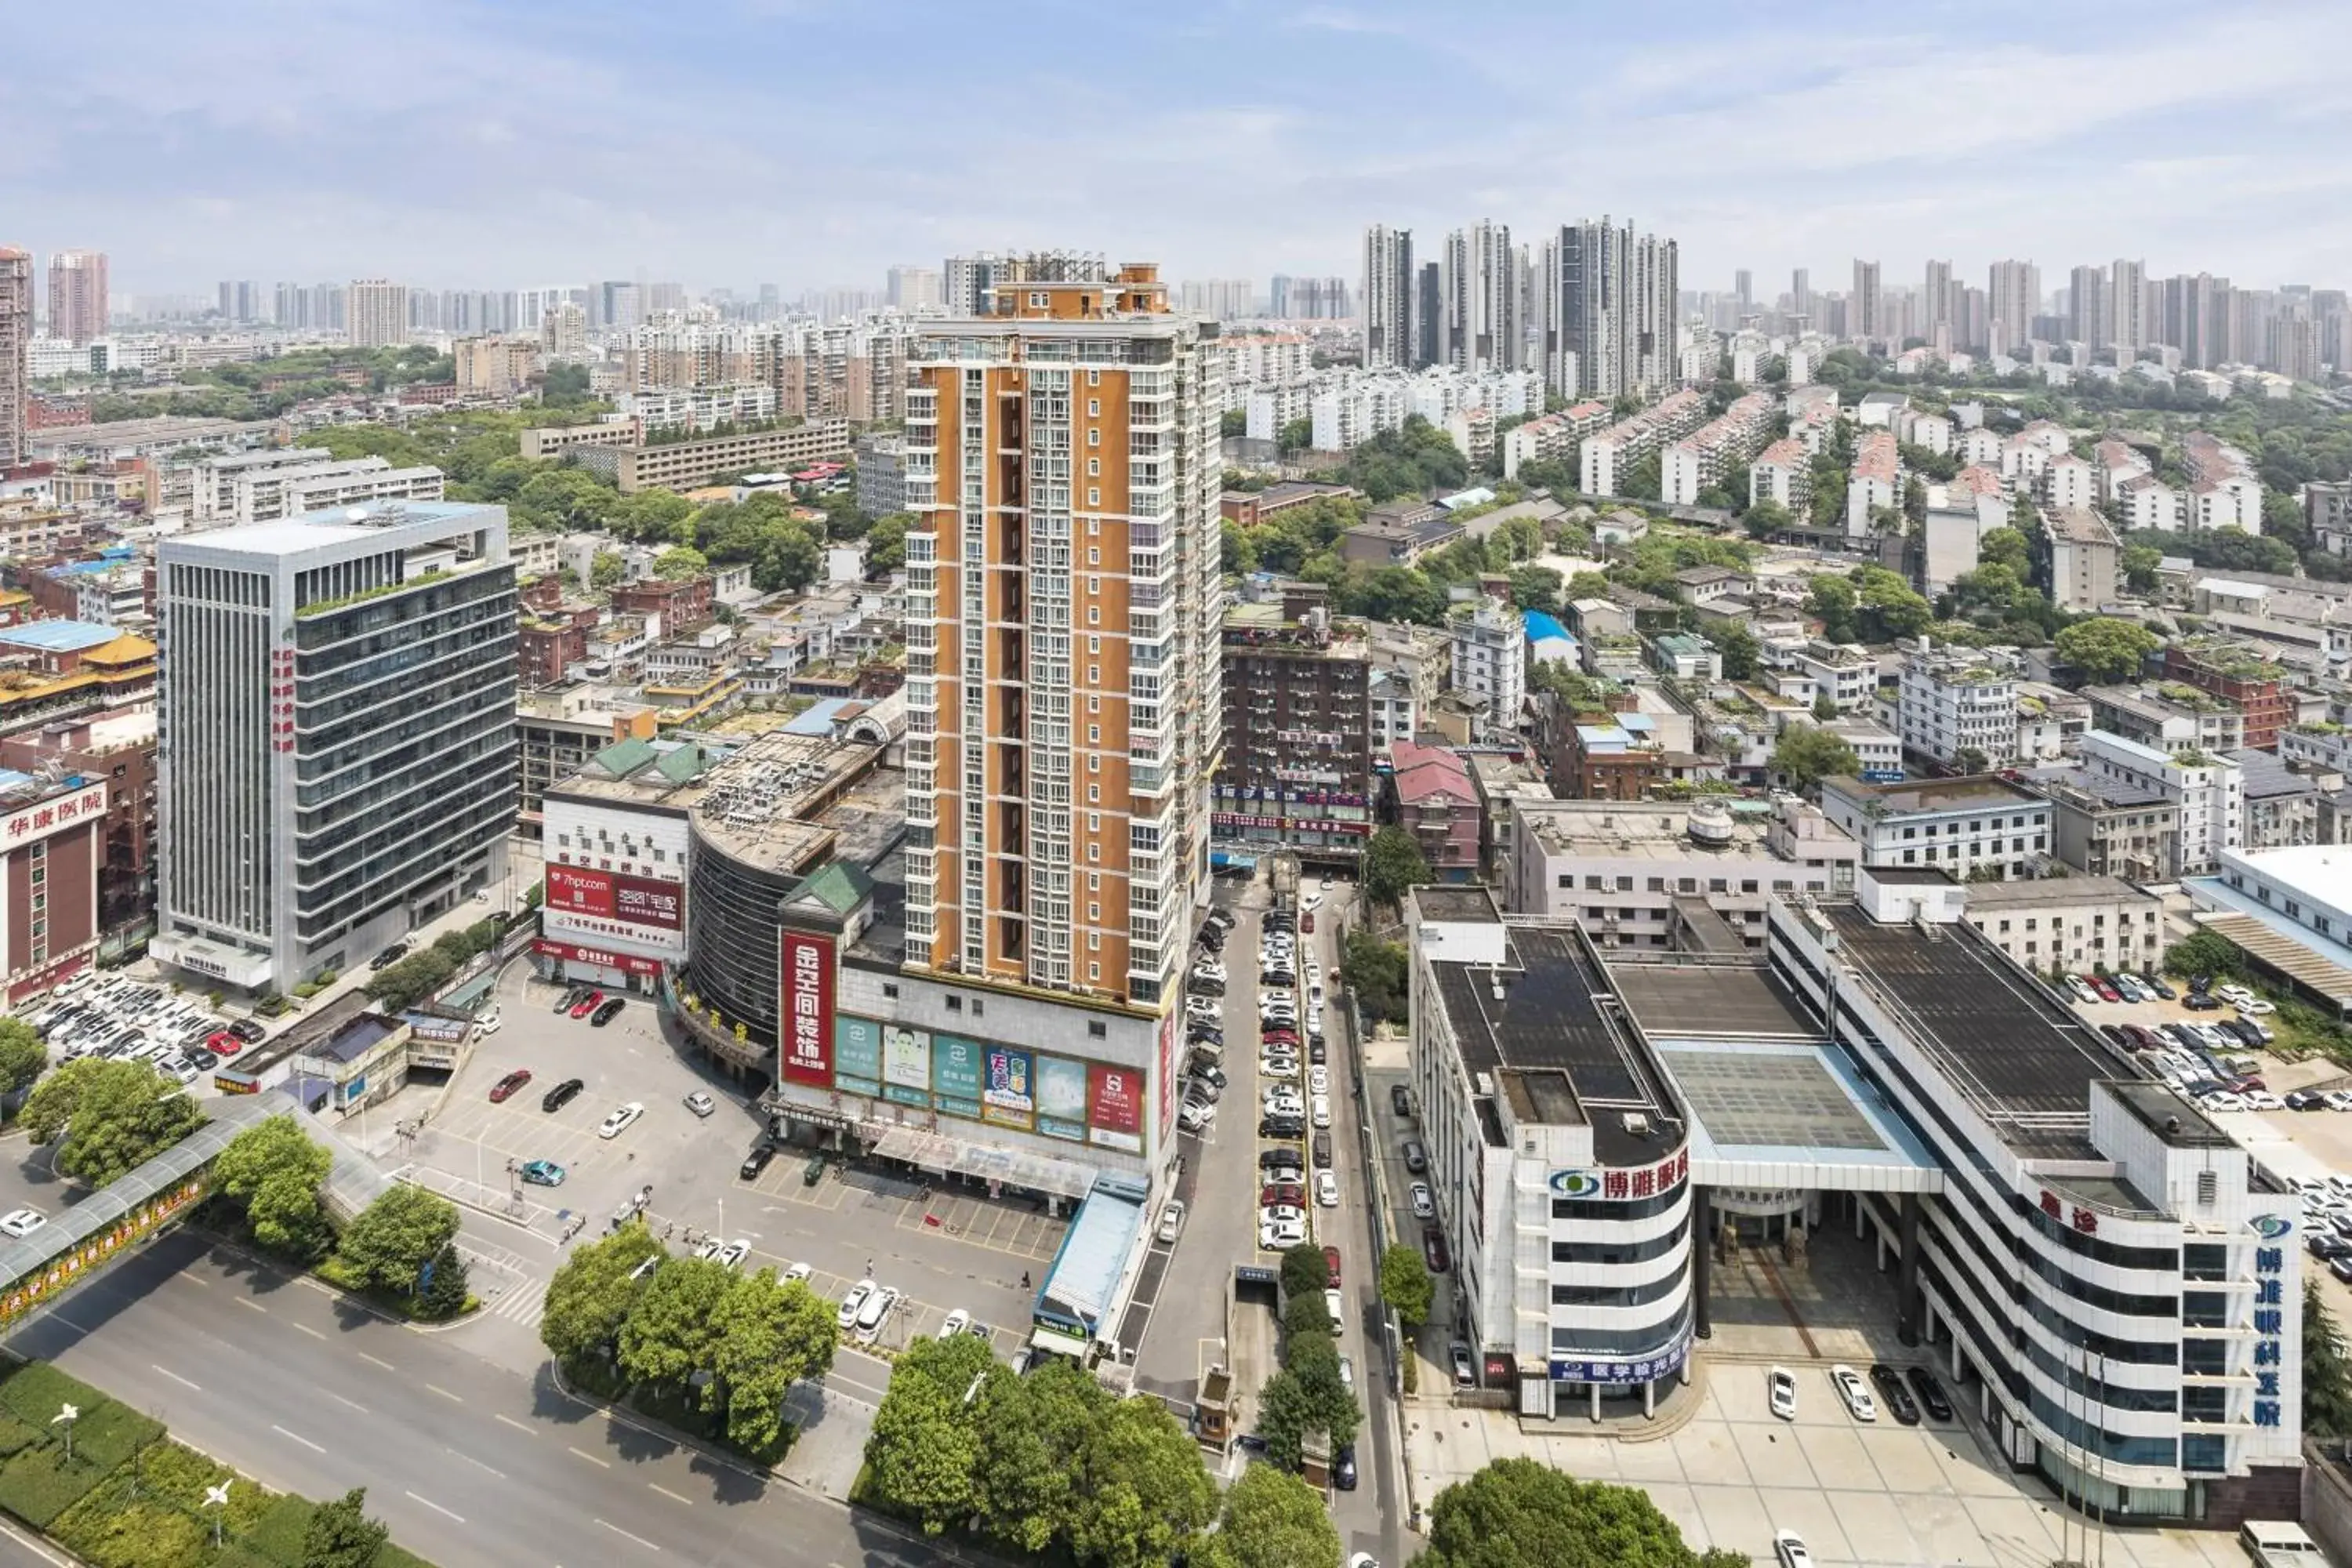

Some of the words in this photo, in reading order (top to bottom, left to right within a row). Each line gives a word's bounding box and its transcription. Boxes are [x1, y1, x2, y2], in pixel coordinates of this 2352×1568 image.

[7, 791, 103, 838] 华康医院
[563, 873, 608, 891] 7hpt.com
[2254, 1247, 2283, 1427] 博雅眼科医院
